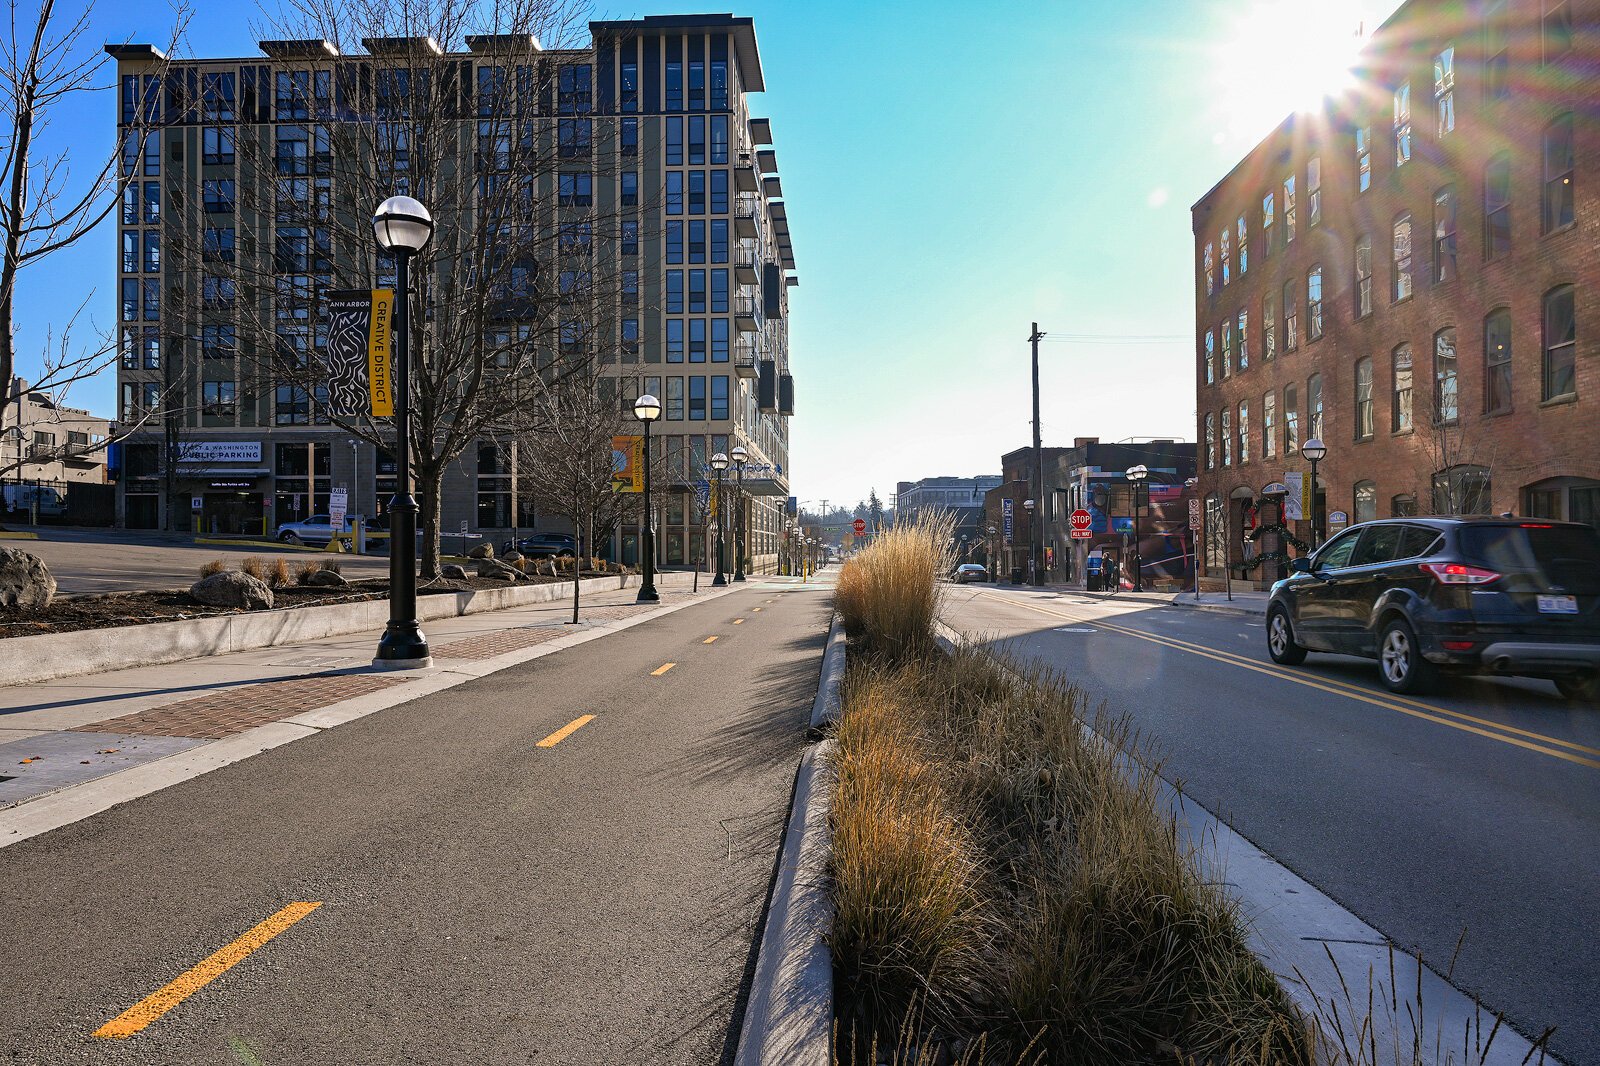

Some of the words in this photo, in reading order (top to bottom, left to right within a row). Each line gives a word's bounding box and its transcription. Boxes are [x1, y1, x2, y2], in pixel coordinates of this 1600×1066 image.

[374, 301, 387, 352] CREATIVE
[374, 355, 387, 404] DISTRICT
[1004, 501, 1012, 517] Pig
[1071, 515, 1090, 524] STOP
